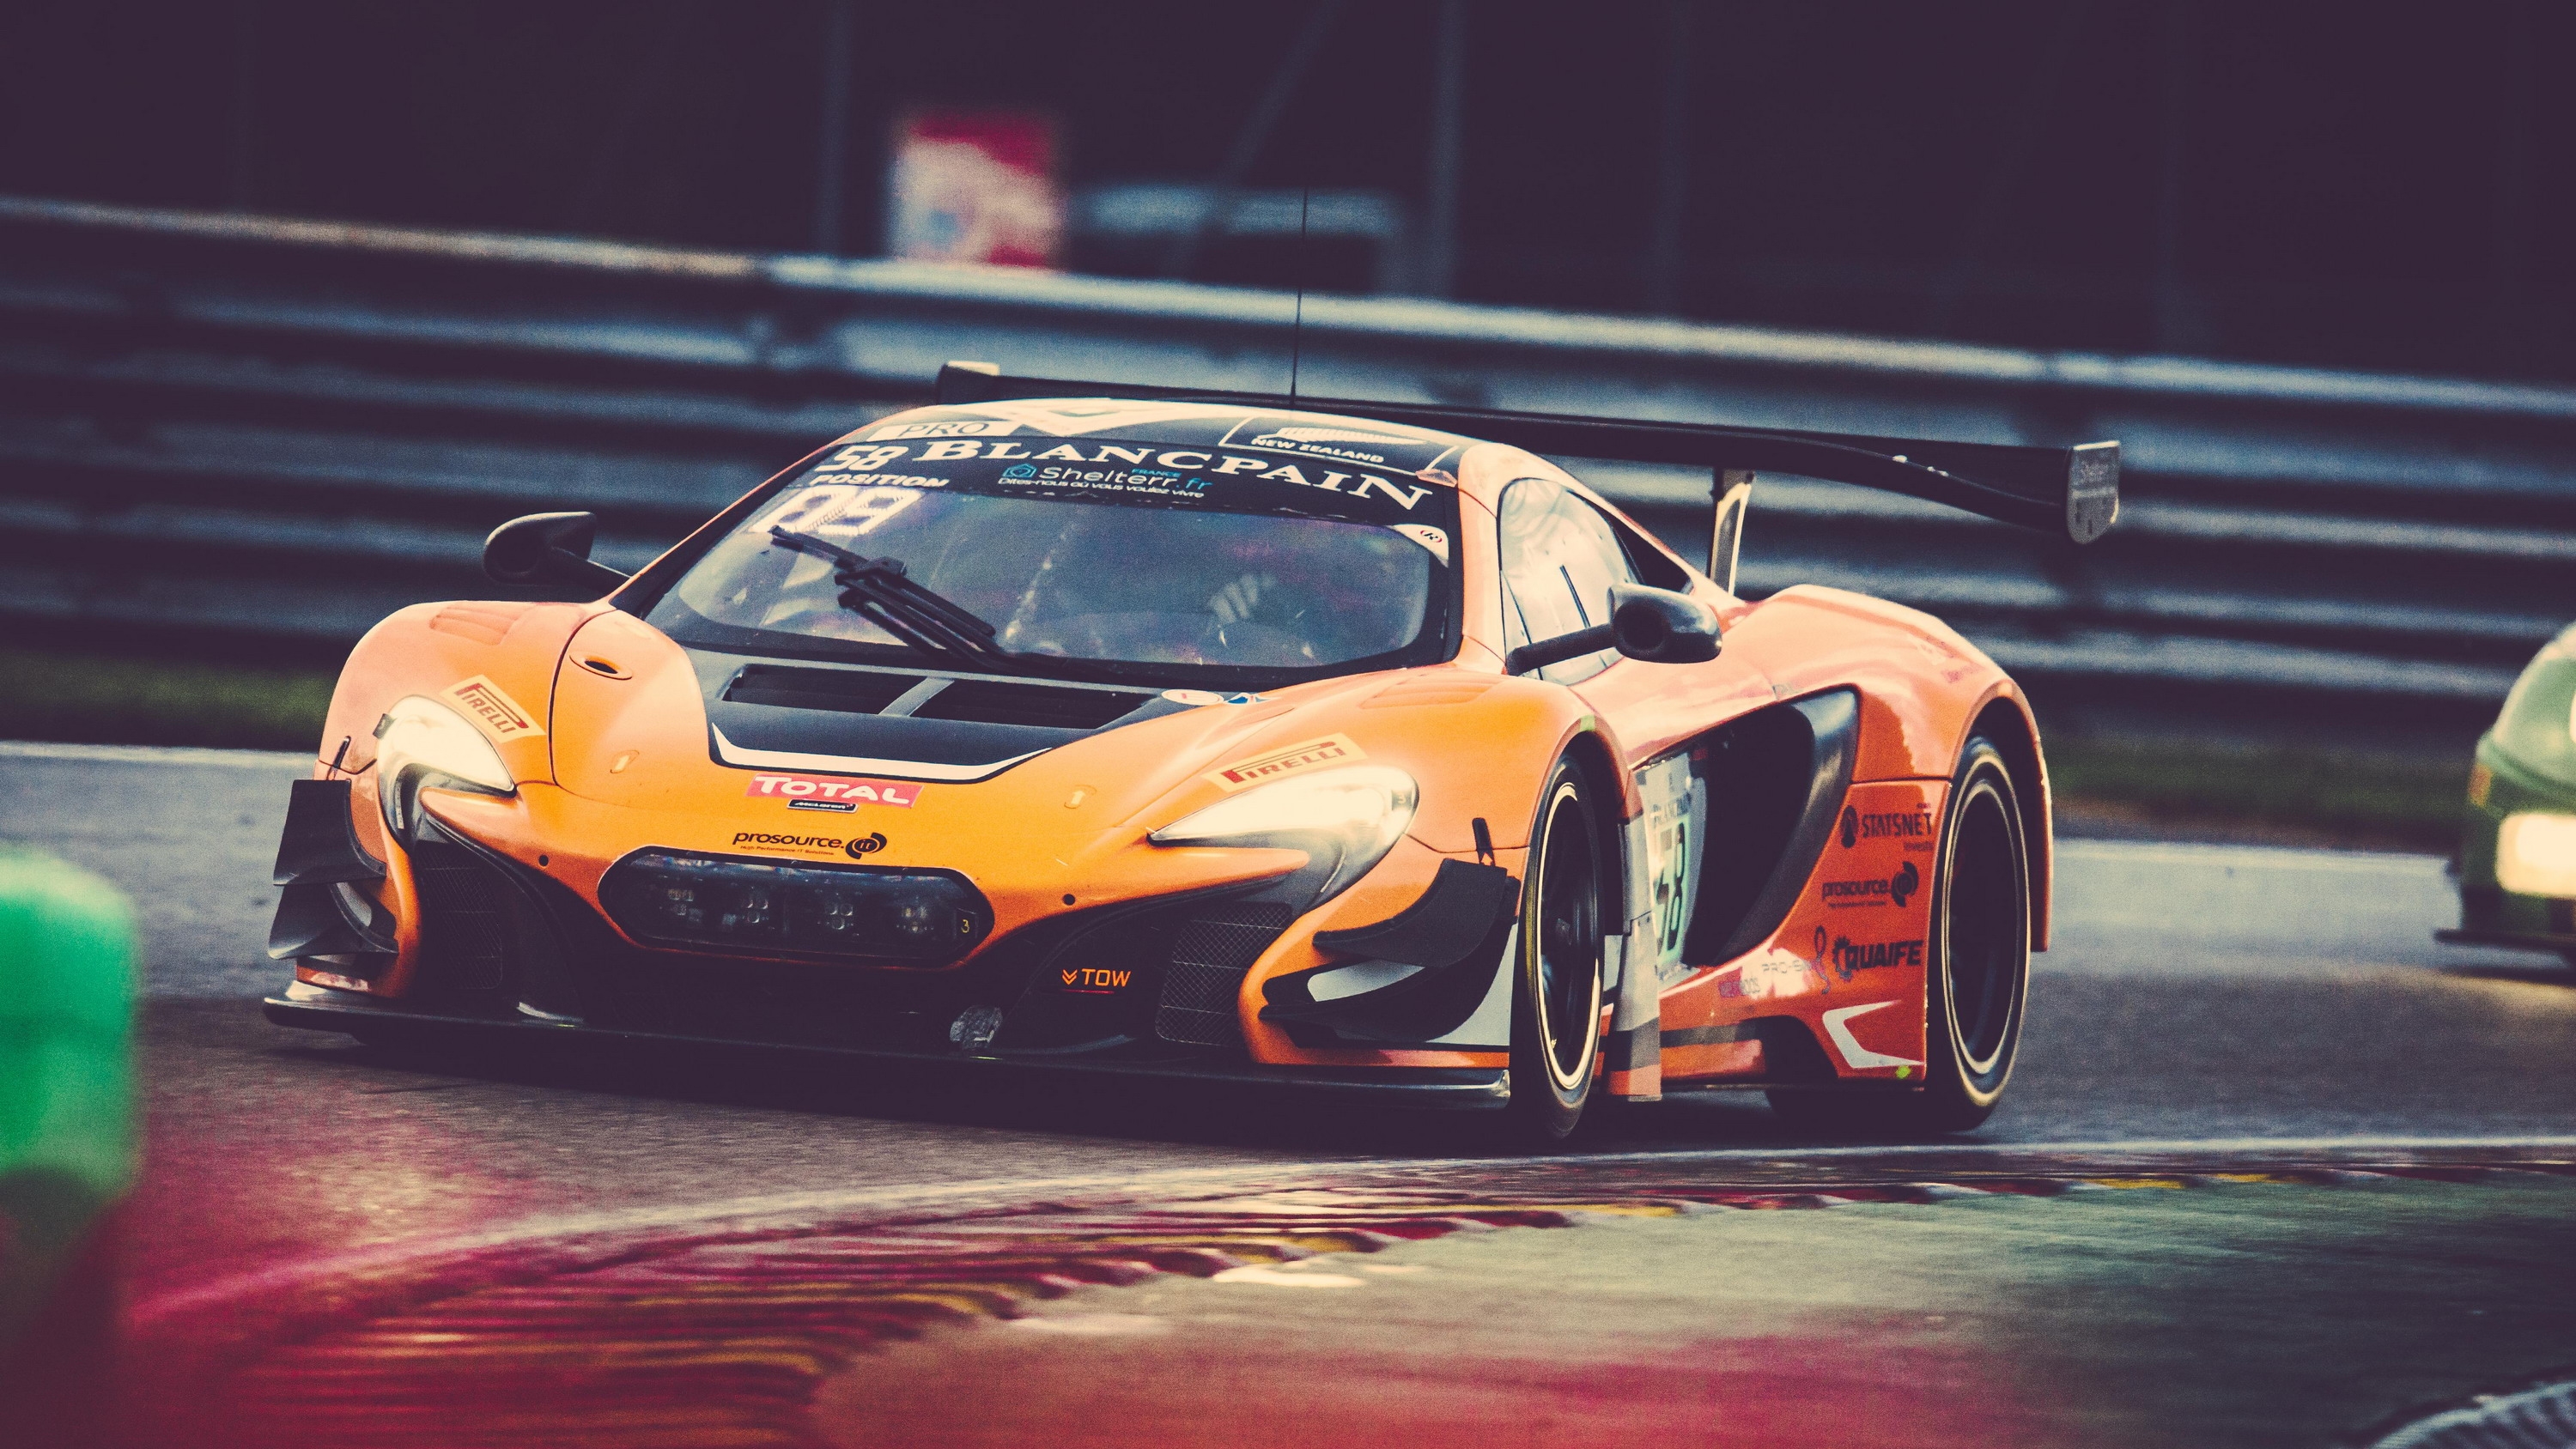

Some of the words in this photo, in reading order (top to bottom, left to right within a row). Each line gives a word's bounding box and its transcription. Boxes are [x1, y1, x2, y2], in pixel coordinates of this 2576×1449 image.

[897, 421, 990, 437] PRO
[814, 445, 909, 472] 58
[1250, 437, 1297, 450] NEW
[1298, 441, 1385, 464] ZEALAND
[809, 473, 950, 488] POSITION
[912, 440, 1433, 511] BLANCPAIN
[1131, 468, 1182, 478] FRANCE
[453, 682, 529, 733] PIRELLI
[1220, 740, 1347, 784] PIRELLI
[754, 776, 910, 805] TOTAL
[960, 919, 970, 933] 3
[1080, 967, 1132, 987] TOW
